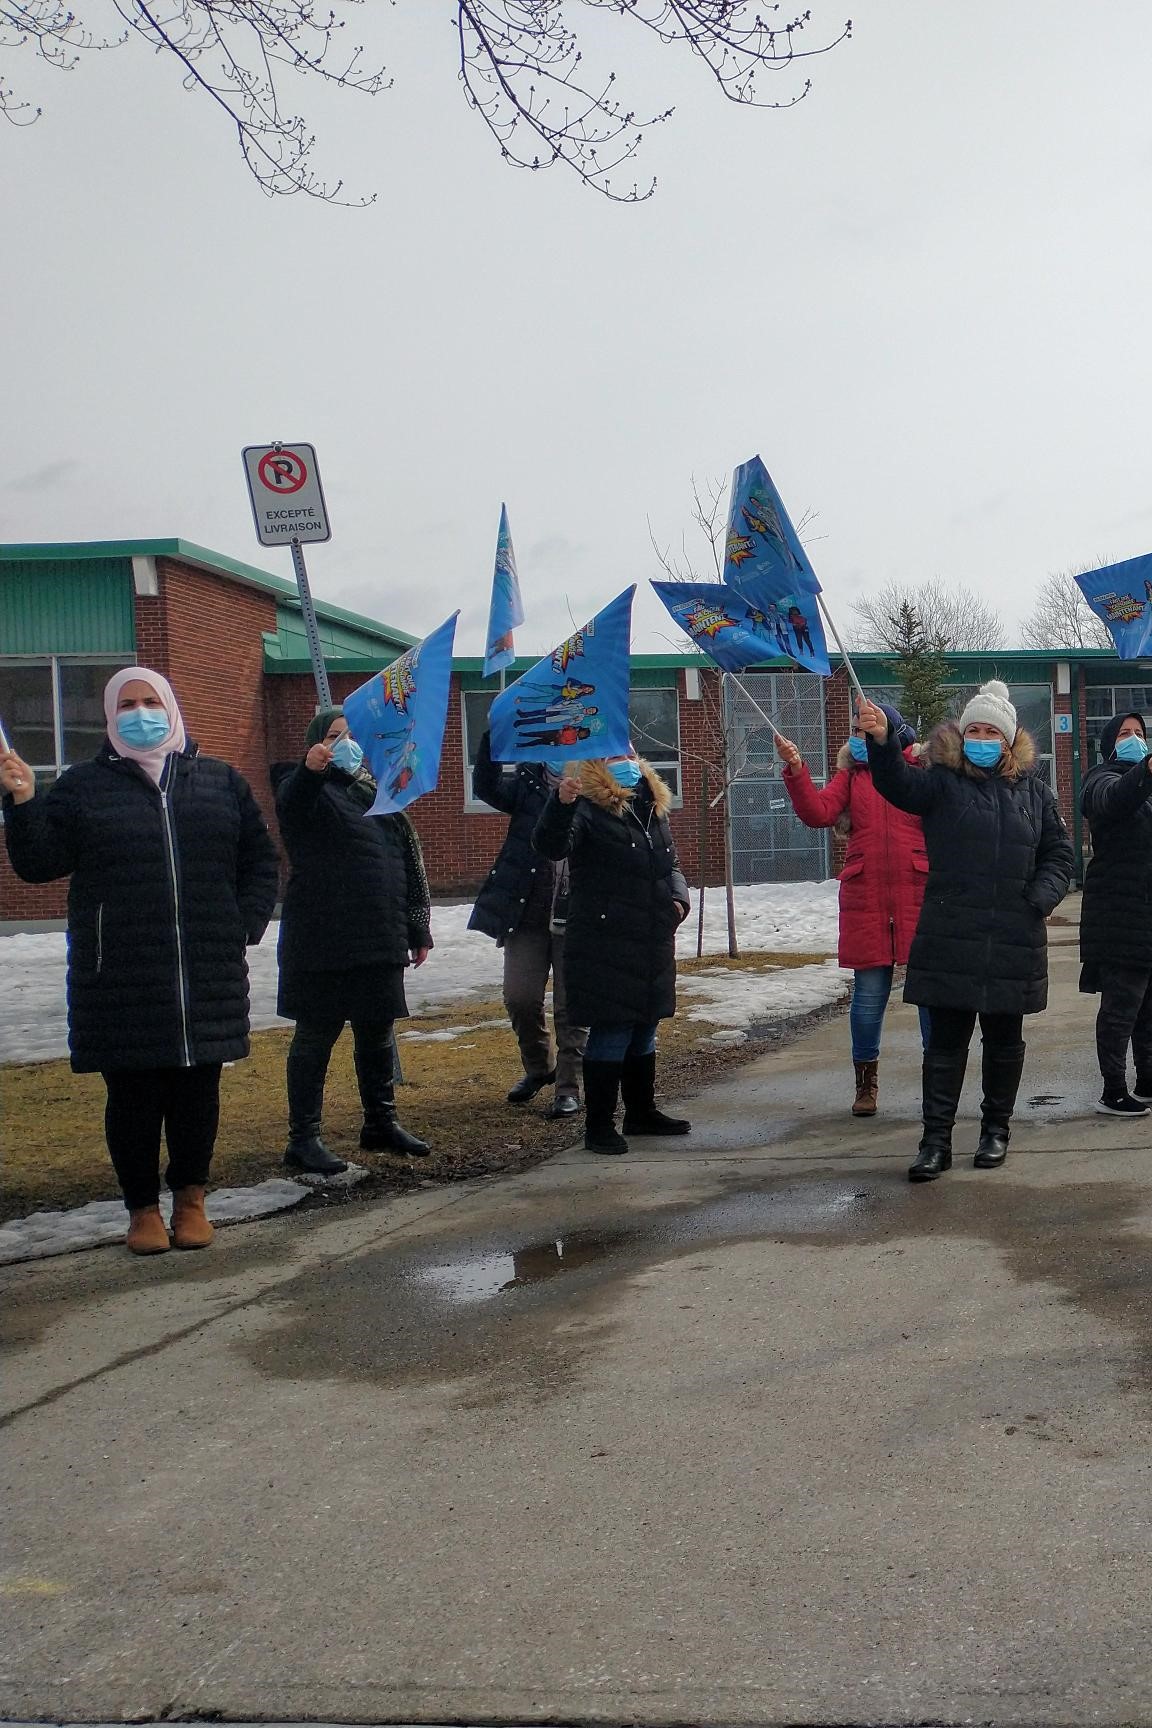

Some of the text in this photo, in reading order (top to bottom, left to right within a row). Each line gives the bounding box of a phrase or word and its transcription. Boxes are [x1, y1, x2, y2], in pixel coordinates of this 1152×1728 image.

[265, 507, 316, 521] EXCEPTÉ
[264, 521, 322, 534] LIVRAISON
[1060, 716, 1069, 731] 3
